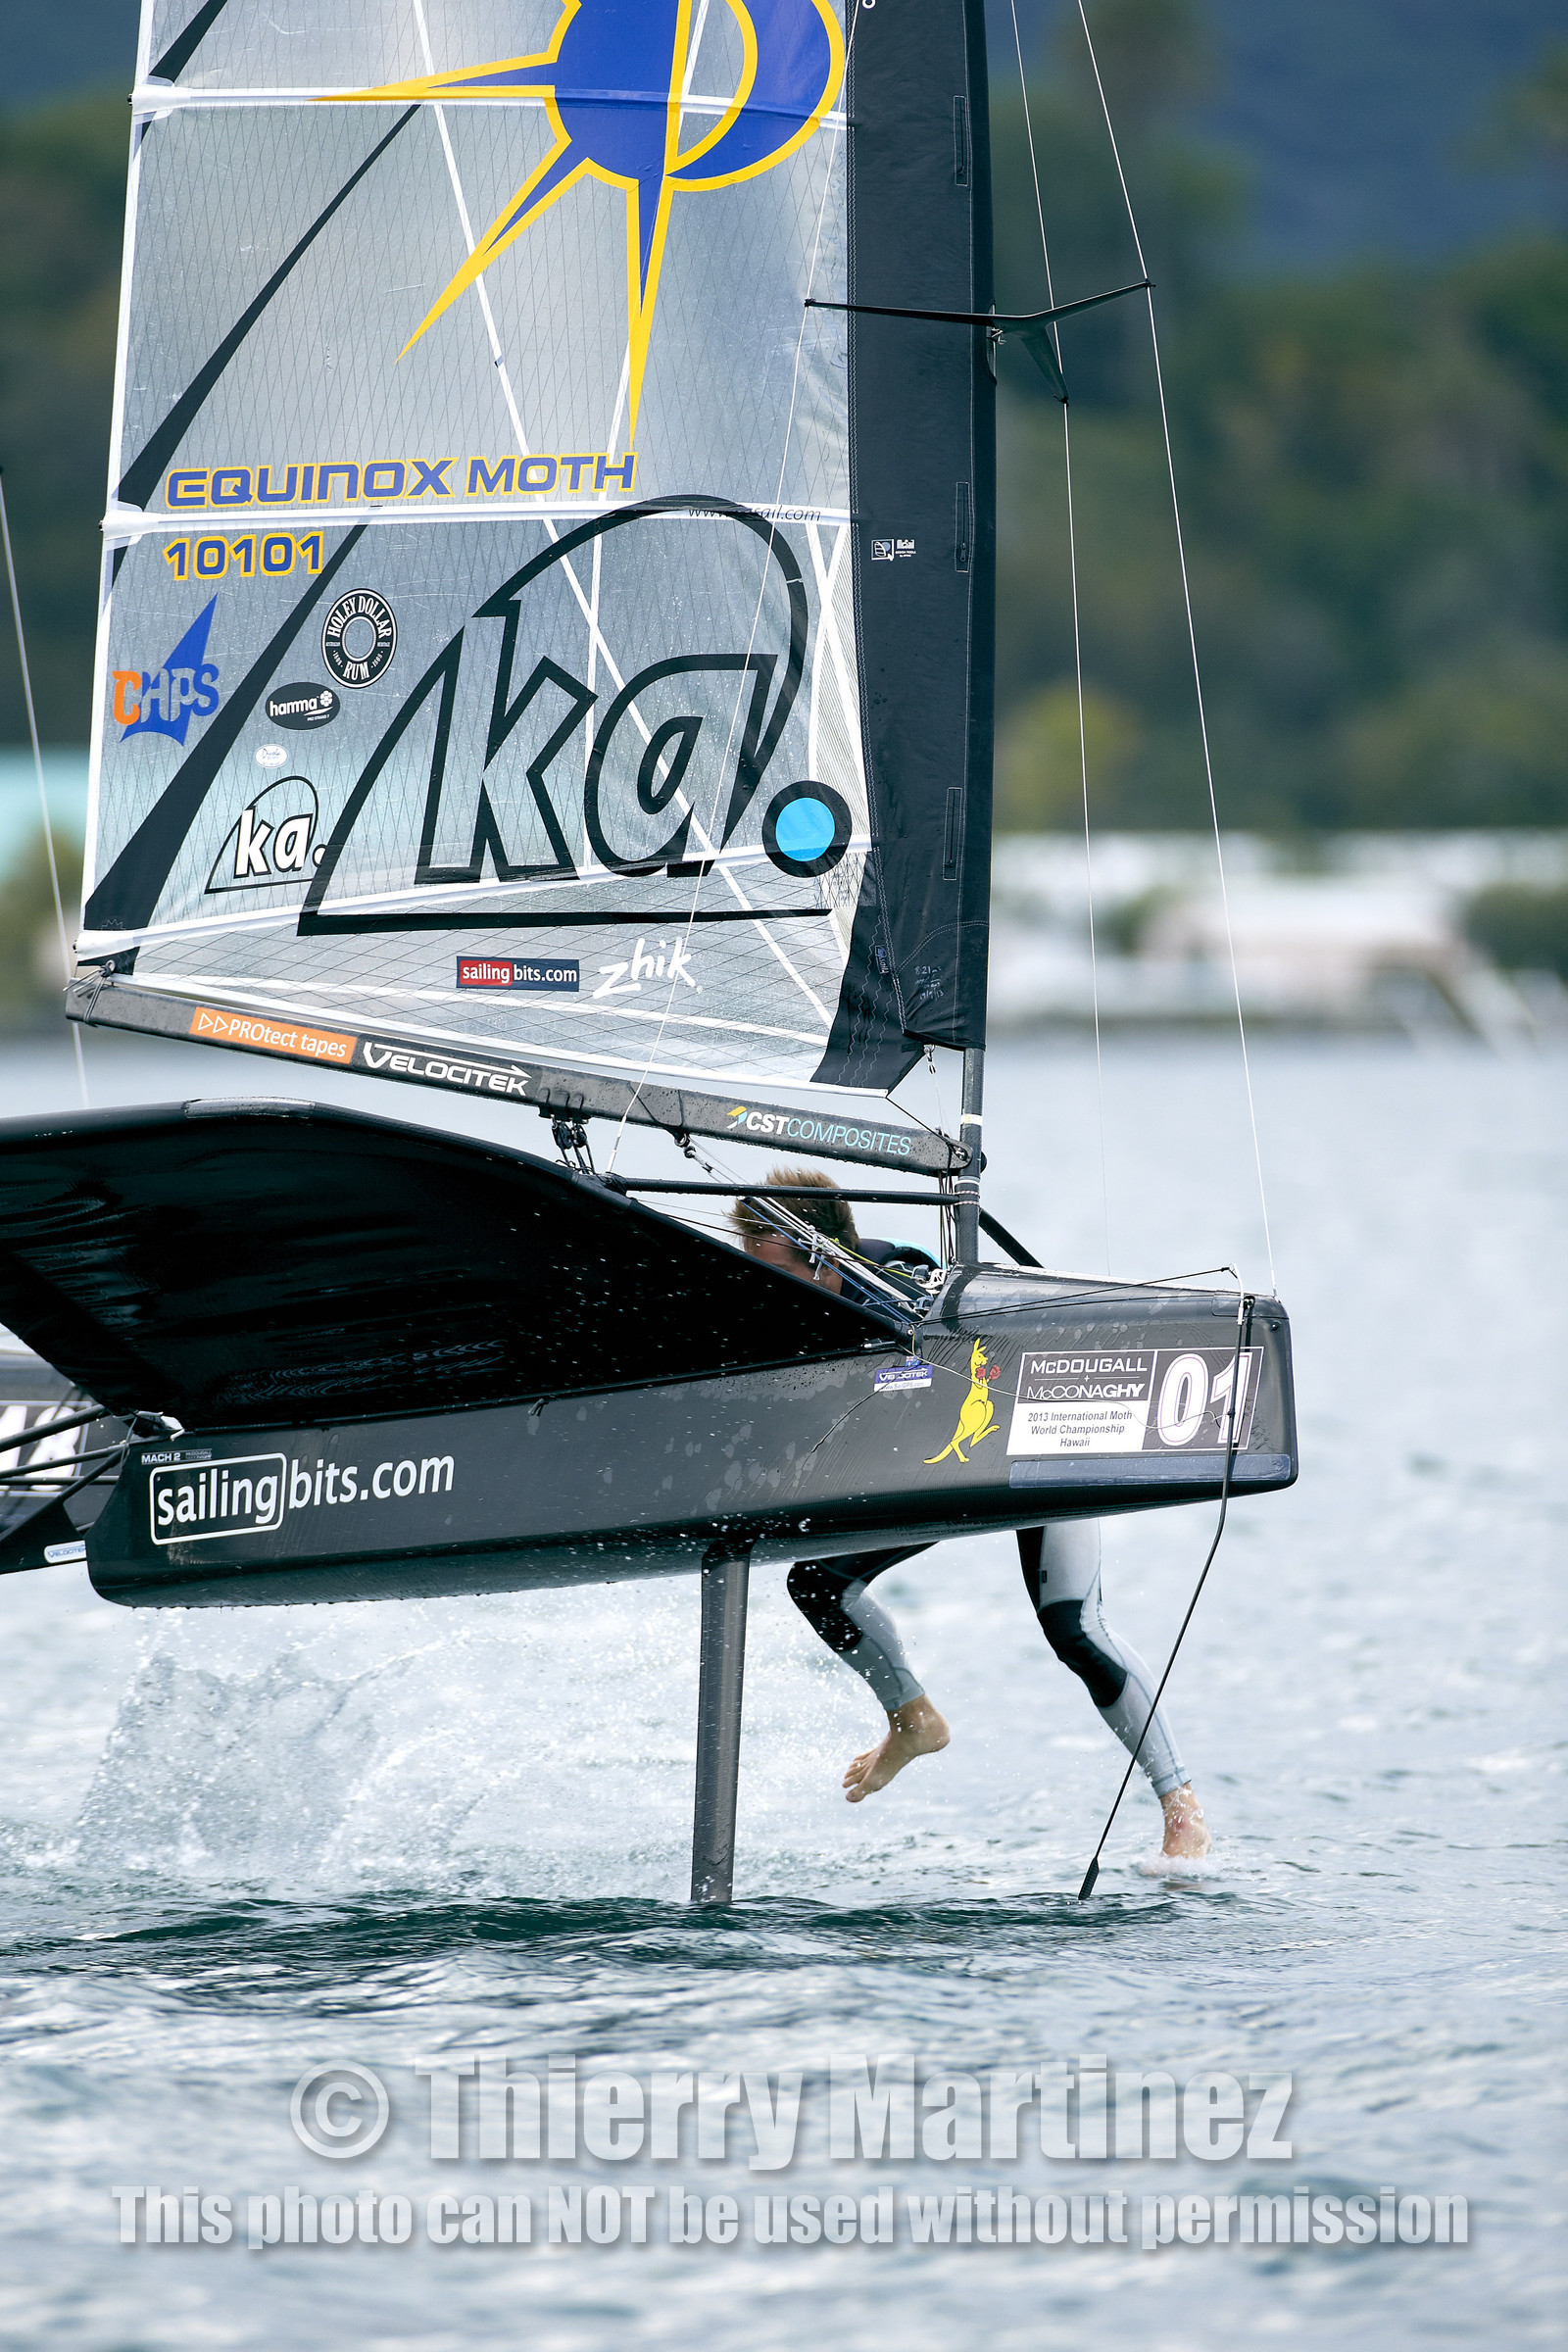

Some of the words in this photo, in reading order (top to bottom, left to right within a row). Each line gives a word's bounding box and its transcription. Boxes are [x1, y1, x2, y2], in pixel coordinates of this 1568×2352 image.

[166, 458, 459, 510] EQUINOX
[465, 452, 638, 497] MOTH
[163, 530, 324, 580] 10101
[326, 596, 357, 638] HOLEY
[358, 595, 392, 639] DOLLAR
[342, 661, 370, 681] RUM
[270, 697, 318, 717] hamma
[229, 1018, 298, 1049] PROtect
[301, 1035, 347, 1058] tapes
[363, 1042, 530, 1097] VELOCITEK
[1157, 1351, 1253, 1446] 01
[1028, 1412, 1049, 1422] 2013
[1051, 1410, 1107, 1422] International
[1109, 1410, 1133, 1420] Moth
[1031, 1425, 1057, 1435] World
[1059, 1424, 1125, 1436] Championship
[141, 1452, 172, 1463] MACH
[1059, 1438, 1091, 1447] Hawaii
